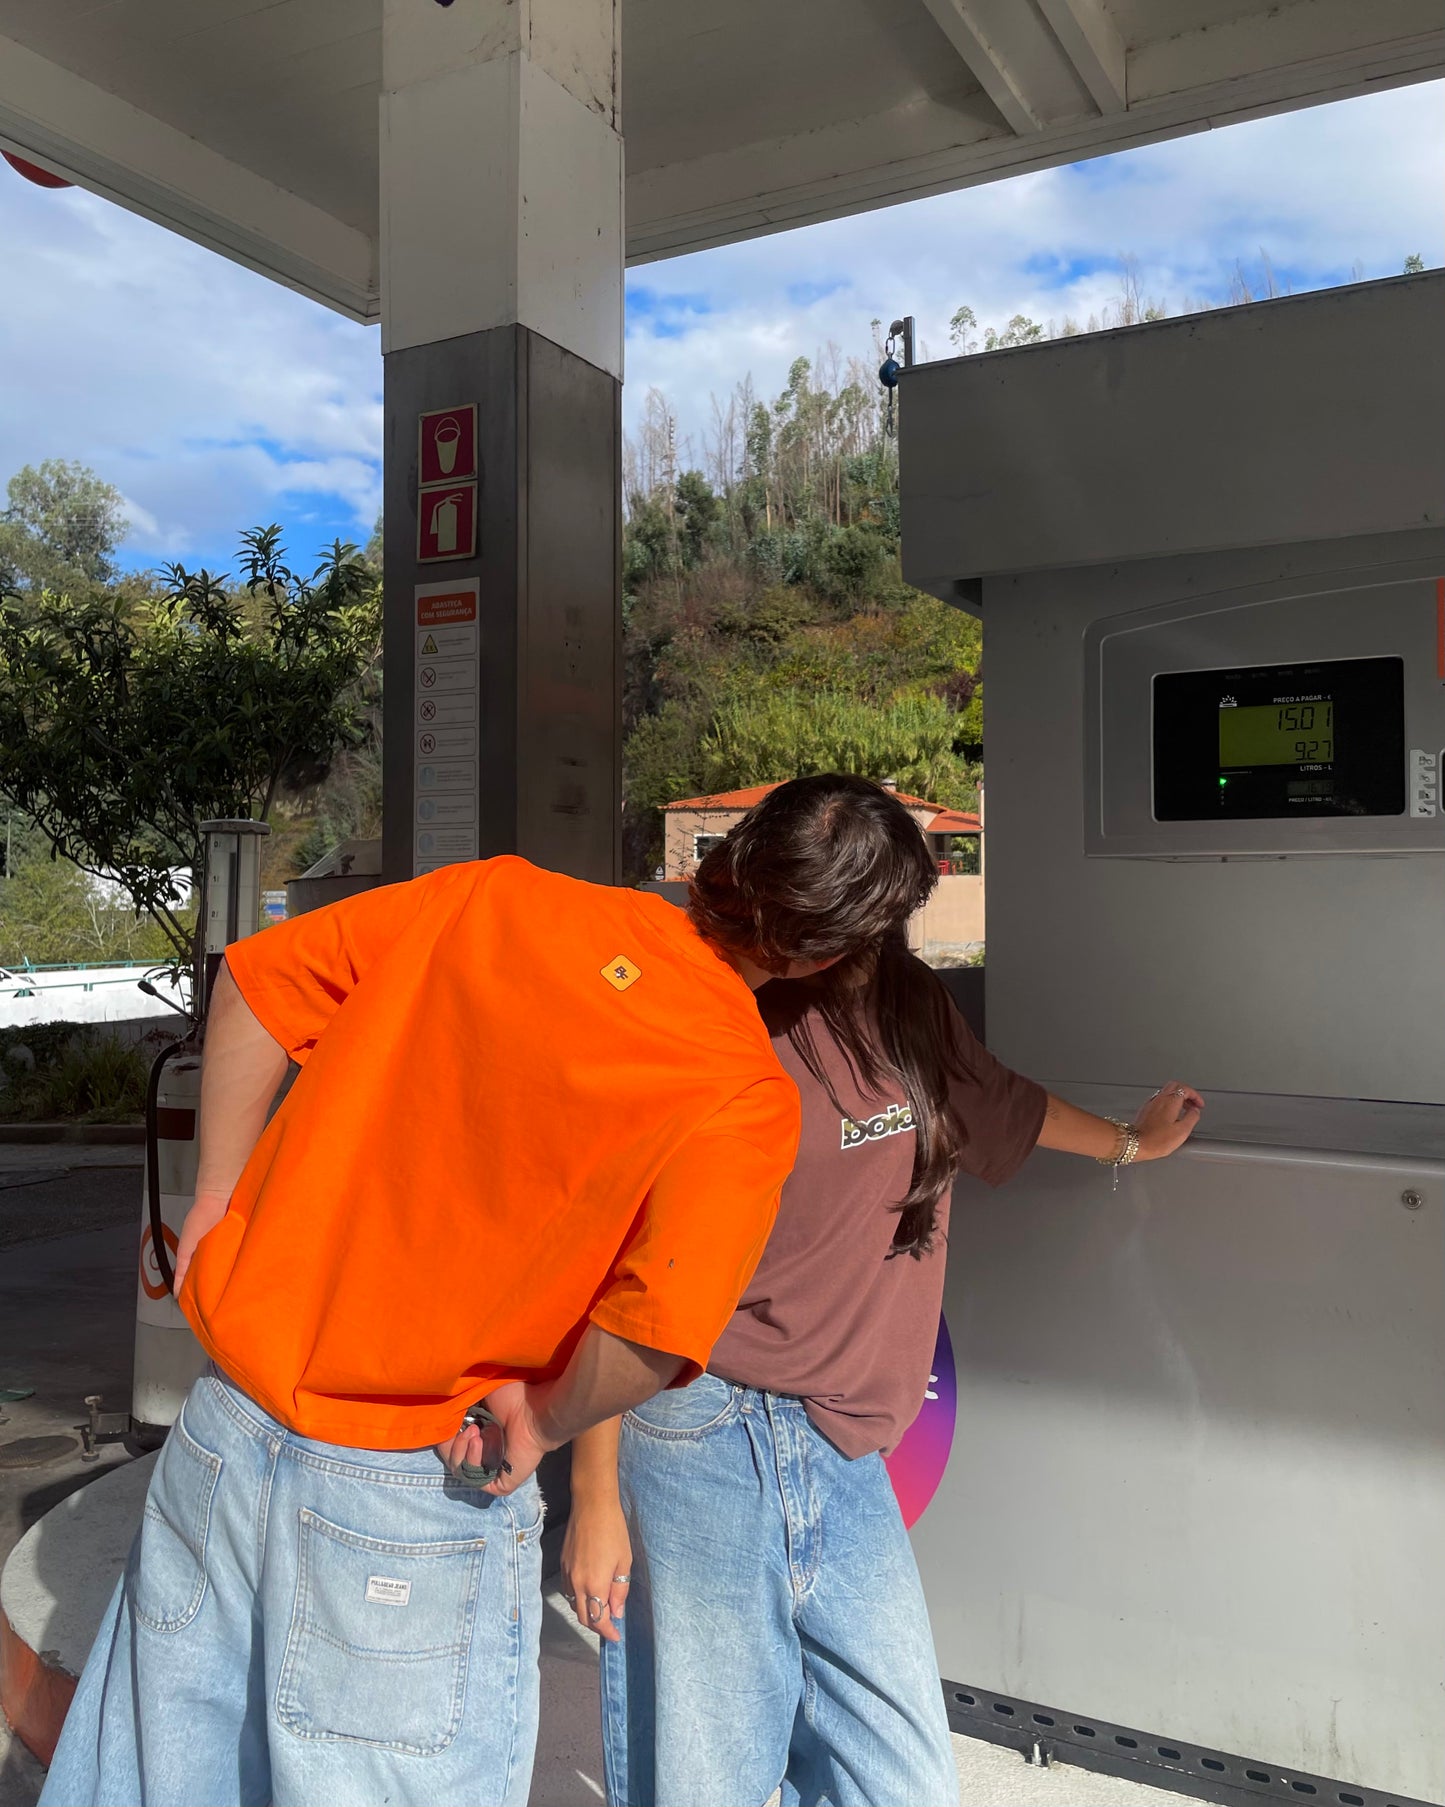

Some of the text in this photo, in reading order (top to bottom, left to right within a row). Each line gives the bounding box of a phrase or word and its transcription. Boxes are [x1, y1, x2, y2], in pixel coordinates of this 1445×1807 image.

[436, 608, 472, 618] SEGURANÇA
[1273, 696, 1294, 704] PREÇO
[1301, 694, 1322, 702] PAGAR
[1278, 706, 1331, 731] 15.01
